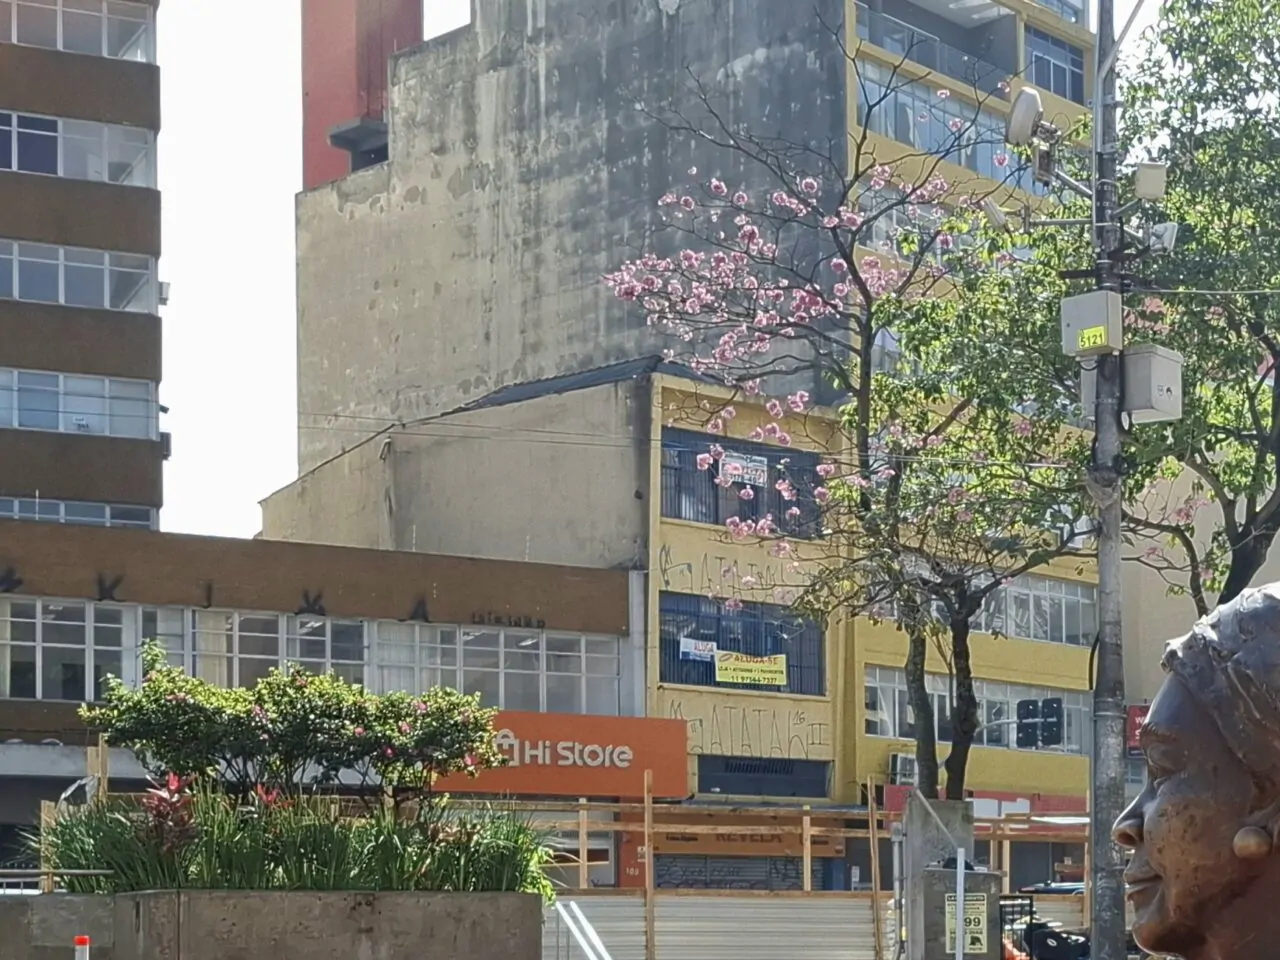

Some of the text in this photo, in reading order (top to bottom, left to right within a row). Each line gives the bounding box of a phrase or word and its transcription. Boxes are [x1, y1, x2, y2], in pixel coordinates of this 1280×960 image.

[1080, 333, 1104, 347] 5121
[524, 740, 633, 768] Hi Store
